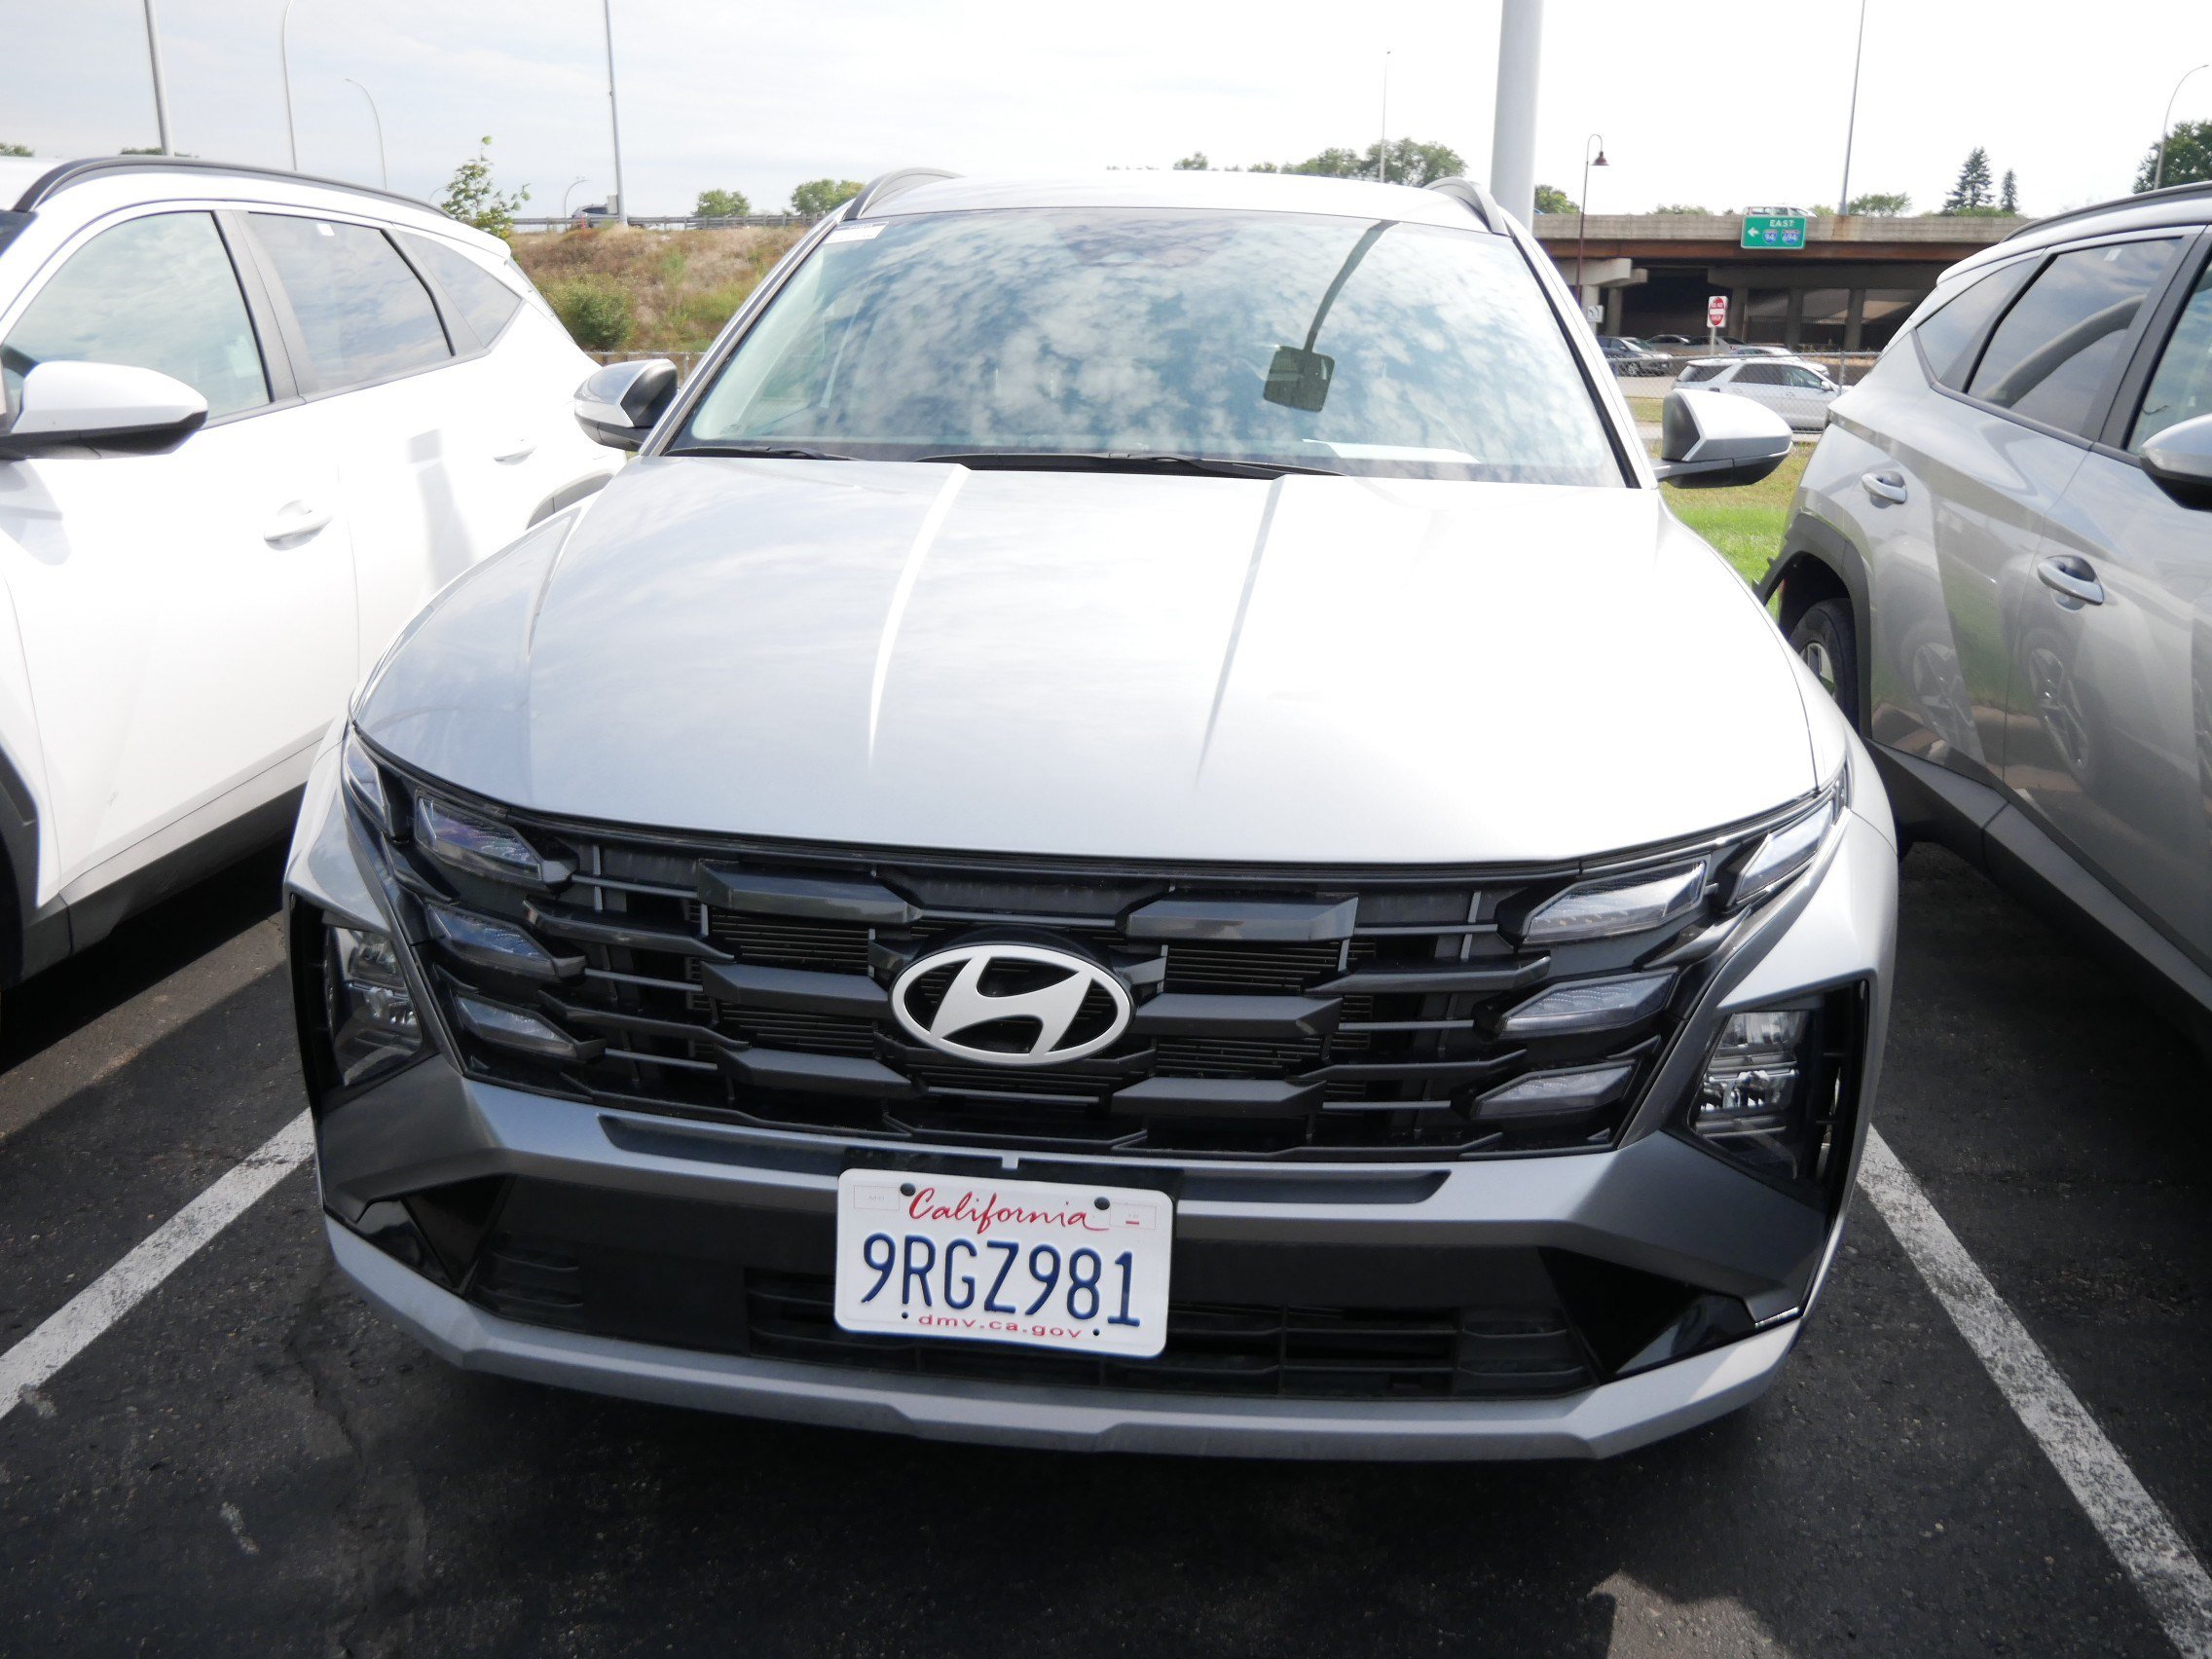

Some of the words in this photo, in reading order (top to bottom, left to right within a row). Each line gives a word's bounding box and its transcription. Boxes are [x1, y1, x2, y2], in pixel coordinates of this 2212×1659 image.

[1769, 219, 1794, 228] EAST
[1764, 233, 1775, 241] 94
[908, 1186, 1110, 1235] California
[861, 1232, 1141, 1327] 9RGZ981
[918, 1313, 1083, 1339] dmv.ca.gov
